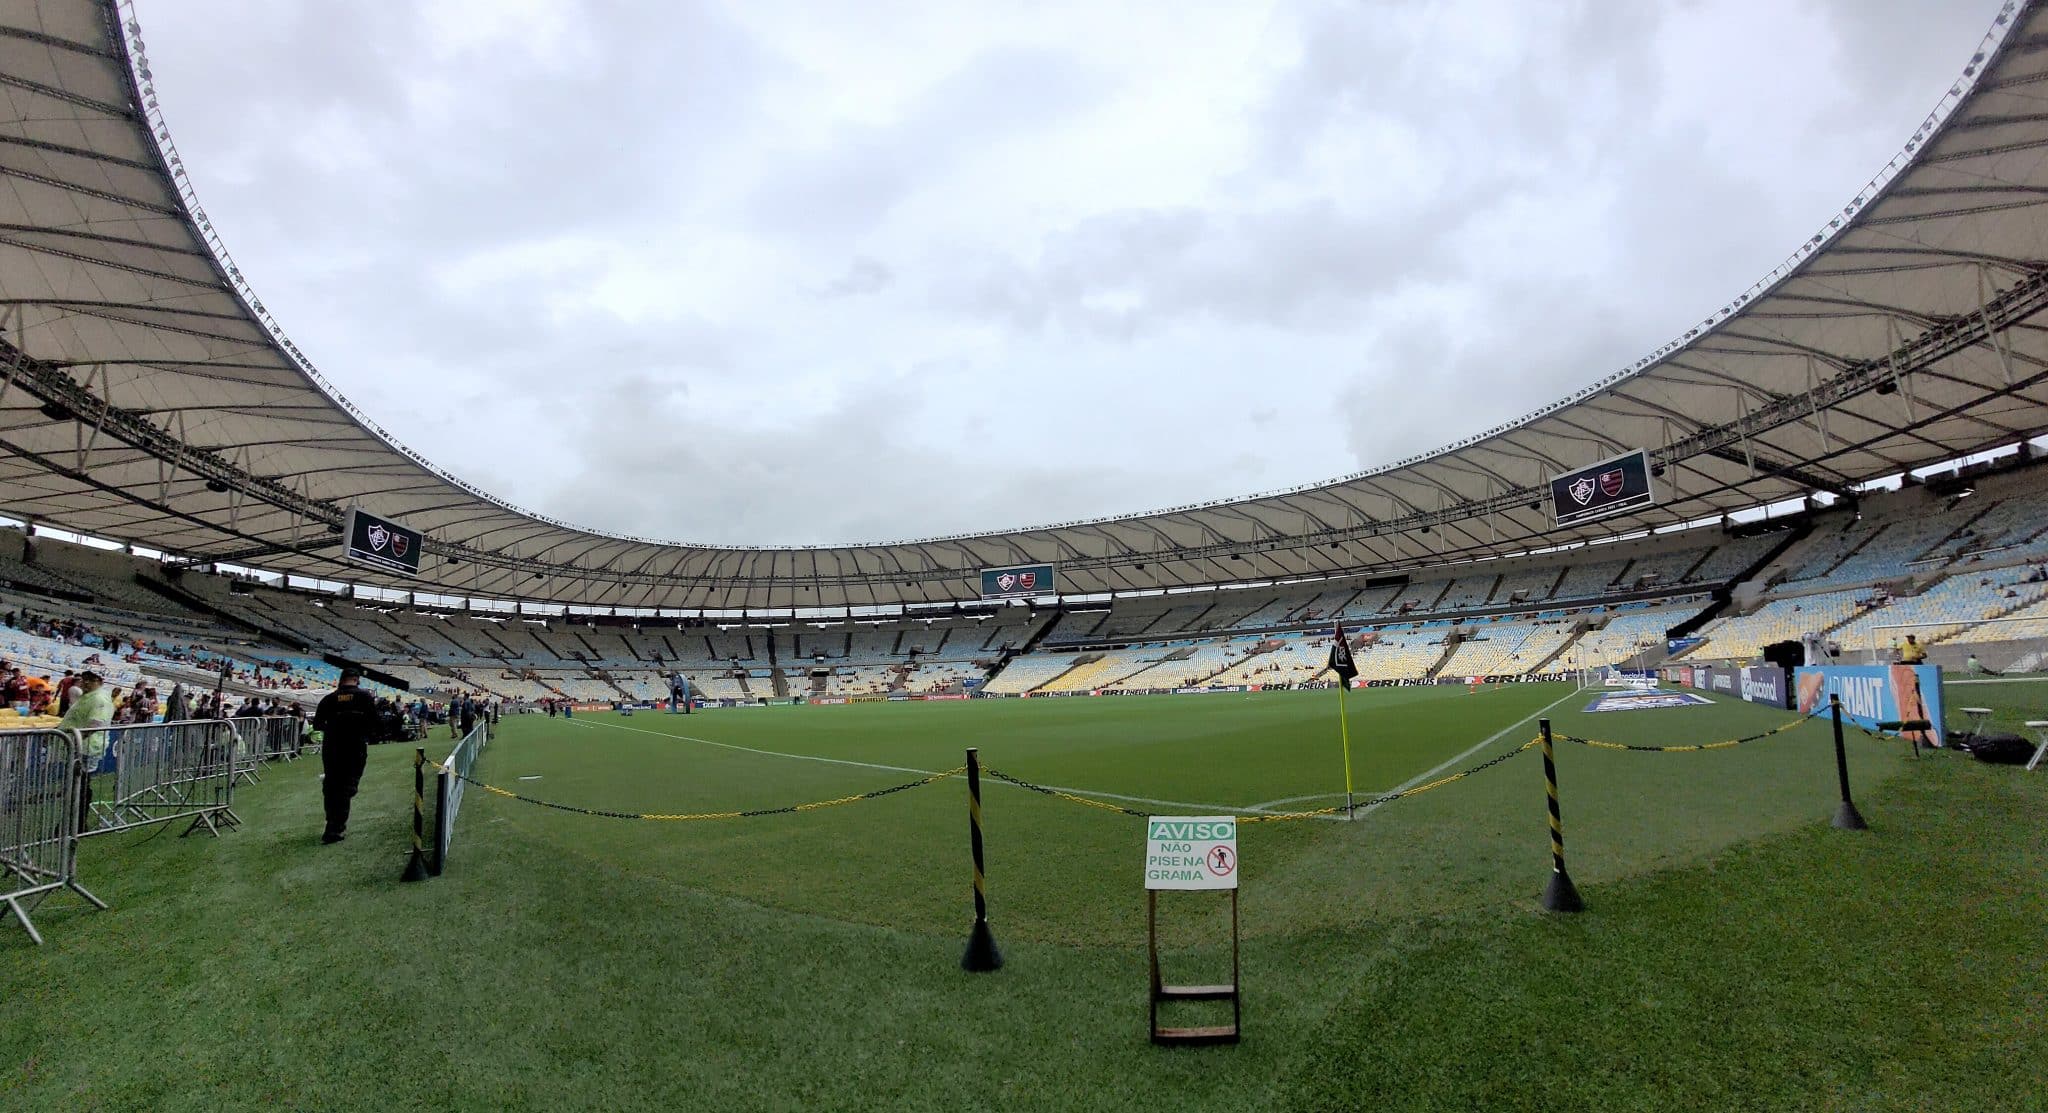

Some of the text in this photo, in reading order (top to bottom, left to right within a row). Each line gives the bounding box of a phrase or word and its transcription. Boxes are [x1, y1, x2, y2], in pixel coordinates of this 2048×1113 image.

[1402, 678, 1434, 687] PNEUS
[1526, 674, 1562, 682] PNEUS
[1298, 682, 1325, 690] PNEUS
[1125, 688, 1148, 696] PNEUS
[1152, 823, 1233, 840] AVISO
[1161, 842, 1192, 853] NÃO
[1149, 856, 1205, 867] PISE NA
[1148, 870, 1204, 881] GRAMA
